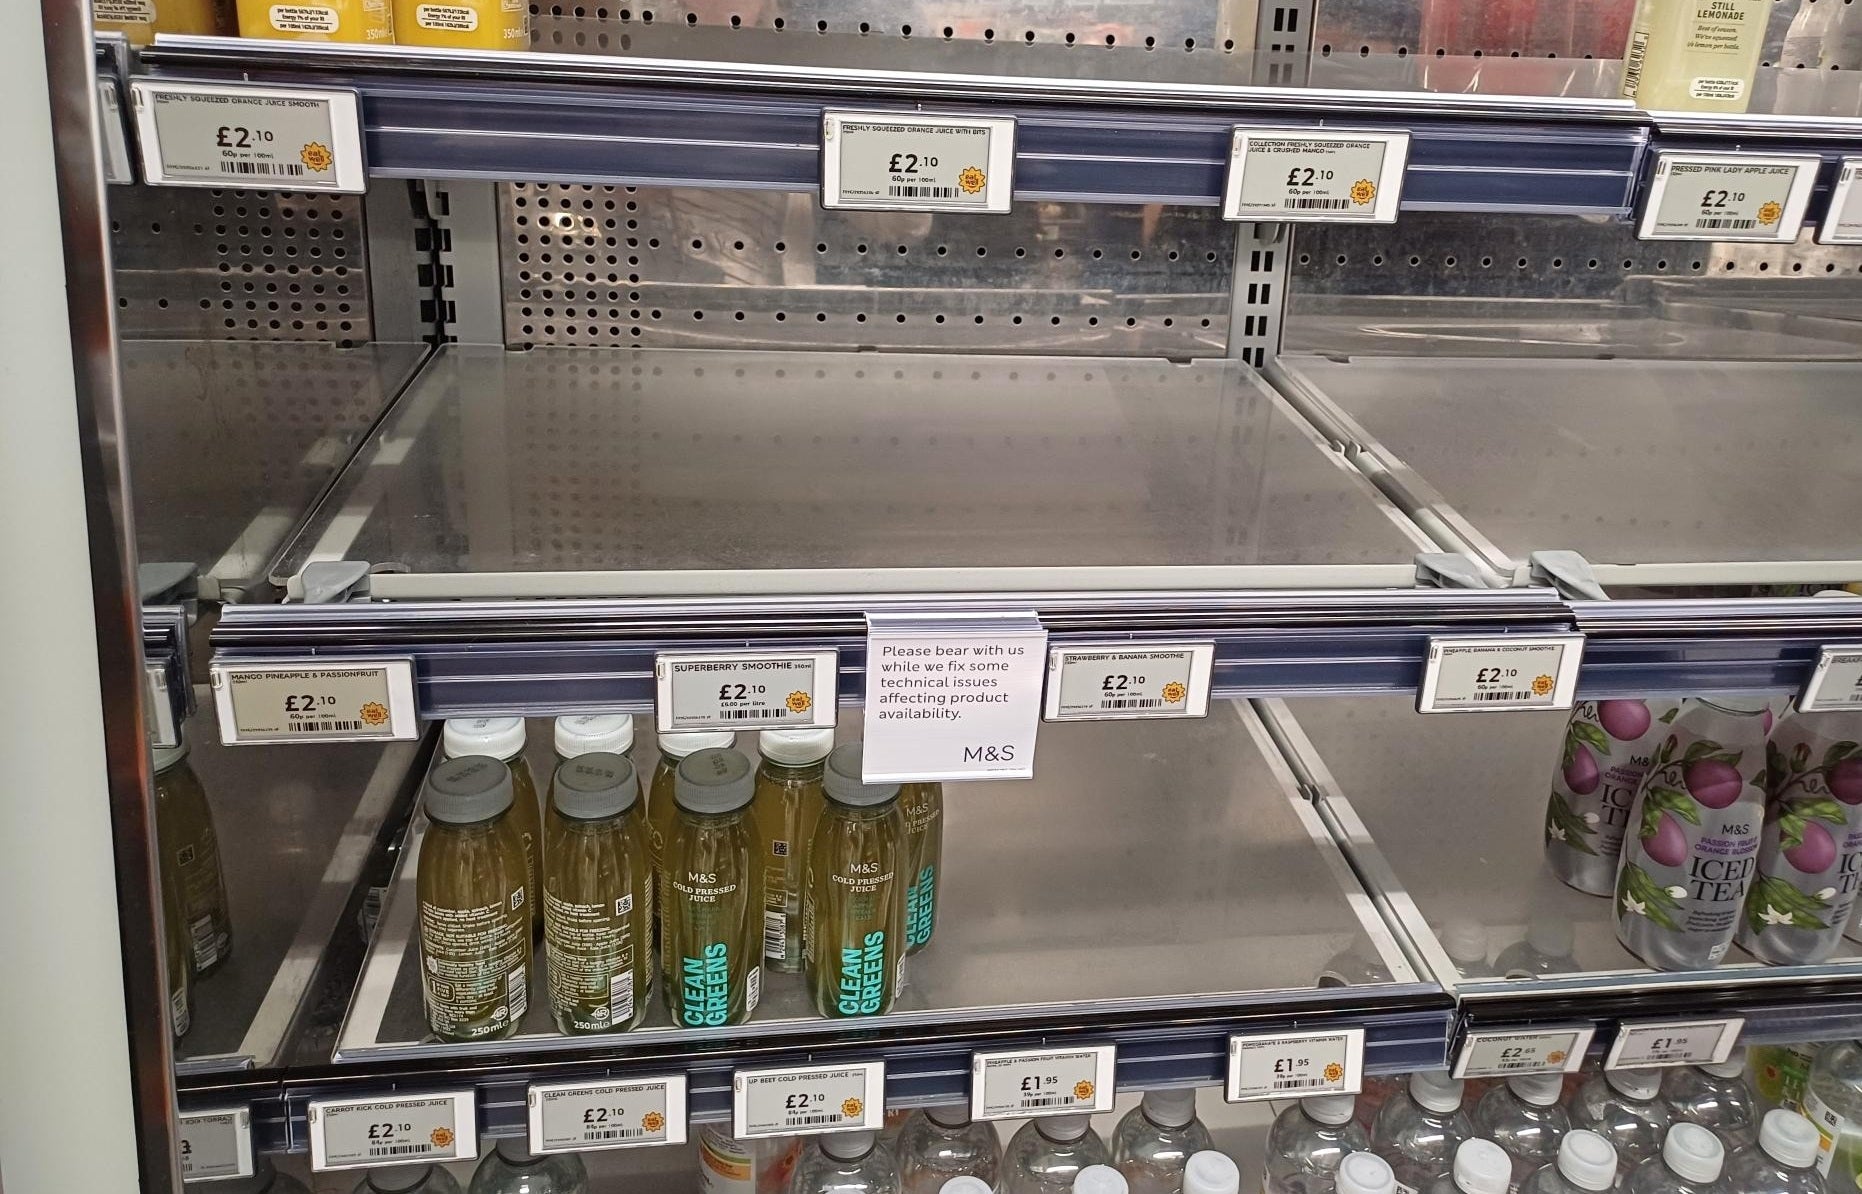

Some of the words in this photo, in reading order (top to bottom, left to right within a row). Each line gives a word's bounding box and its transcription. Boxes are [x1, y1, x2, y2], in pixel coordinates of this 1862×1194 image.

[1712, 2, 1734, 10] STILL
[1698, 10, 1744, 20] LEMONADE
[190, 95, 229, 104] SQUEEZED
[216, 126, 273, 148] £2.10
[889, 154, 938, 173] £2.10
[1287, 168, 1334, 186] £2.10
[1701, 190, 1745, 207] £2.10
[883, 646, 931, 656] Please
[936, 646, 969, 656] bear
[973, 645, 1003, 655] with
[1008, 646, 1024, 655] us
[675, 664, 738, 672] SUPERBERRY
[742, 662, 792, 670] SMOOTHIE
[882, 661, 920, 672] while
[948, 661, 965, 671] fix
[970, 662, 1009, 671] some
[881, 677, 950, 687] technical
[953, 676, 997, 687] issues
[1102, 675, 1145, 690] £2.10
[1476, 668, 1517, 683] £2.10
[719, 684, 765, 700] £2.10
[880, 693, 946, 705] affecting
[950, 692, 1008, 705] product
[285, 695, 336, 712] £2.10
[879, 708, 961, 720] availability.
[964, 745, 1014, 762] M&S
[1630, 755, 1649, 766] M&
[906, 803, 929, 817] M&S
[1722, 824, 1749, 835] M&S
[1701, 837, 1736, 847] PASSION
[1694, 844, 1730, 855] ORANGE
[850, 862, 879, 873] M&S
[1688, 856, 1755, 881] ICED
[688, 872, 717, 884] M&S
[832, 875, 855, 885] COLD
[857, 872, 894, 885] PRESSED
[673, 881, 693, 894] COLD
[695, 885, 736, 895] PRESSED
[1690, 879, 1745, 902] TEA
[689, 895, 716, 903] JUICE
[917, 864, 934, 944] GREENS
[860, 930, 885, 1016] GREENS
[705, 943, 728, 1026] GREENS
[838, 948, 863, 1016] CLEAN
[684, 957, 704, 1026] CLEAN
[1274, 1059, 1309, 1072] £1.95
[799, 1073, 827, 1081] PRESSED
[1021, 1076, 1058, 1090] £1.95
[786, 1094, 824, 1108] £2.10
[584, 1108, 624, 1123] £2.10
[368, 1123, 411, 1138] £2.10
